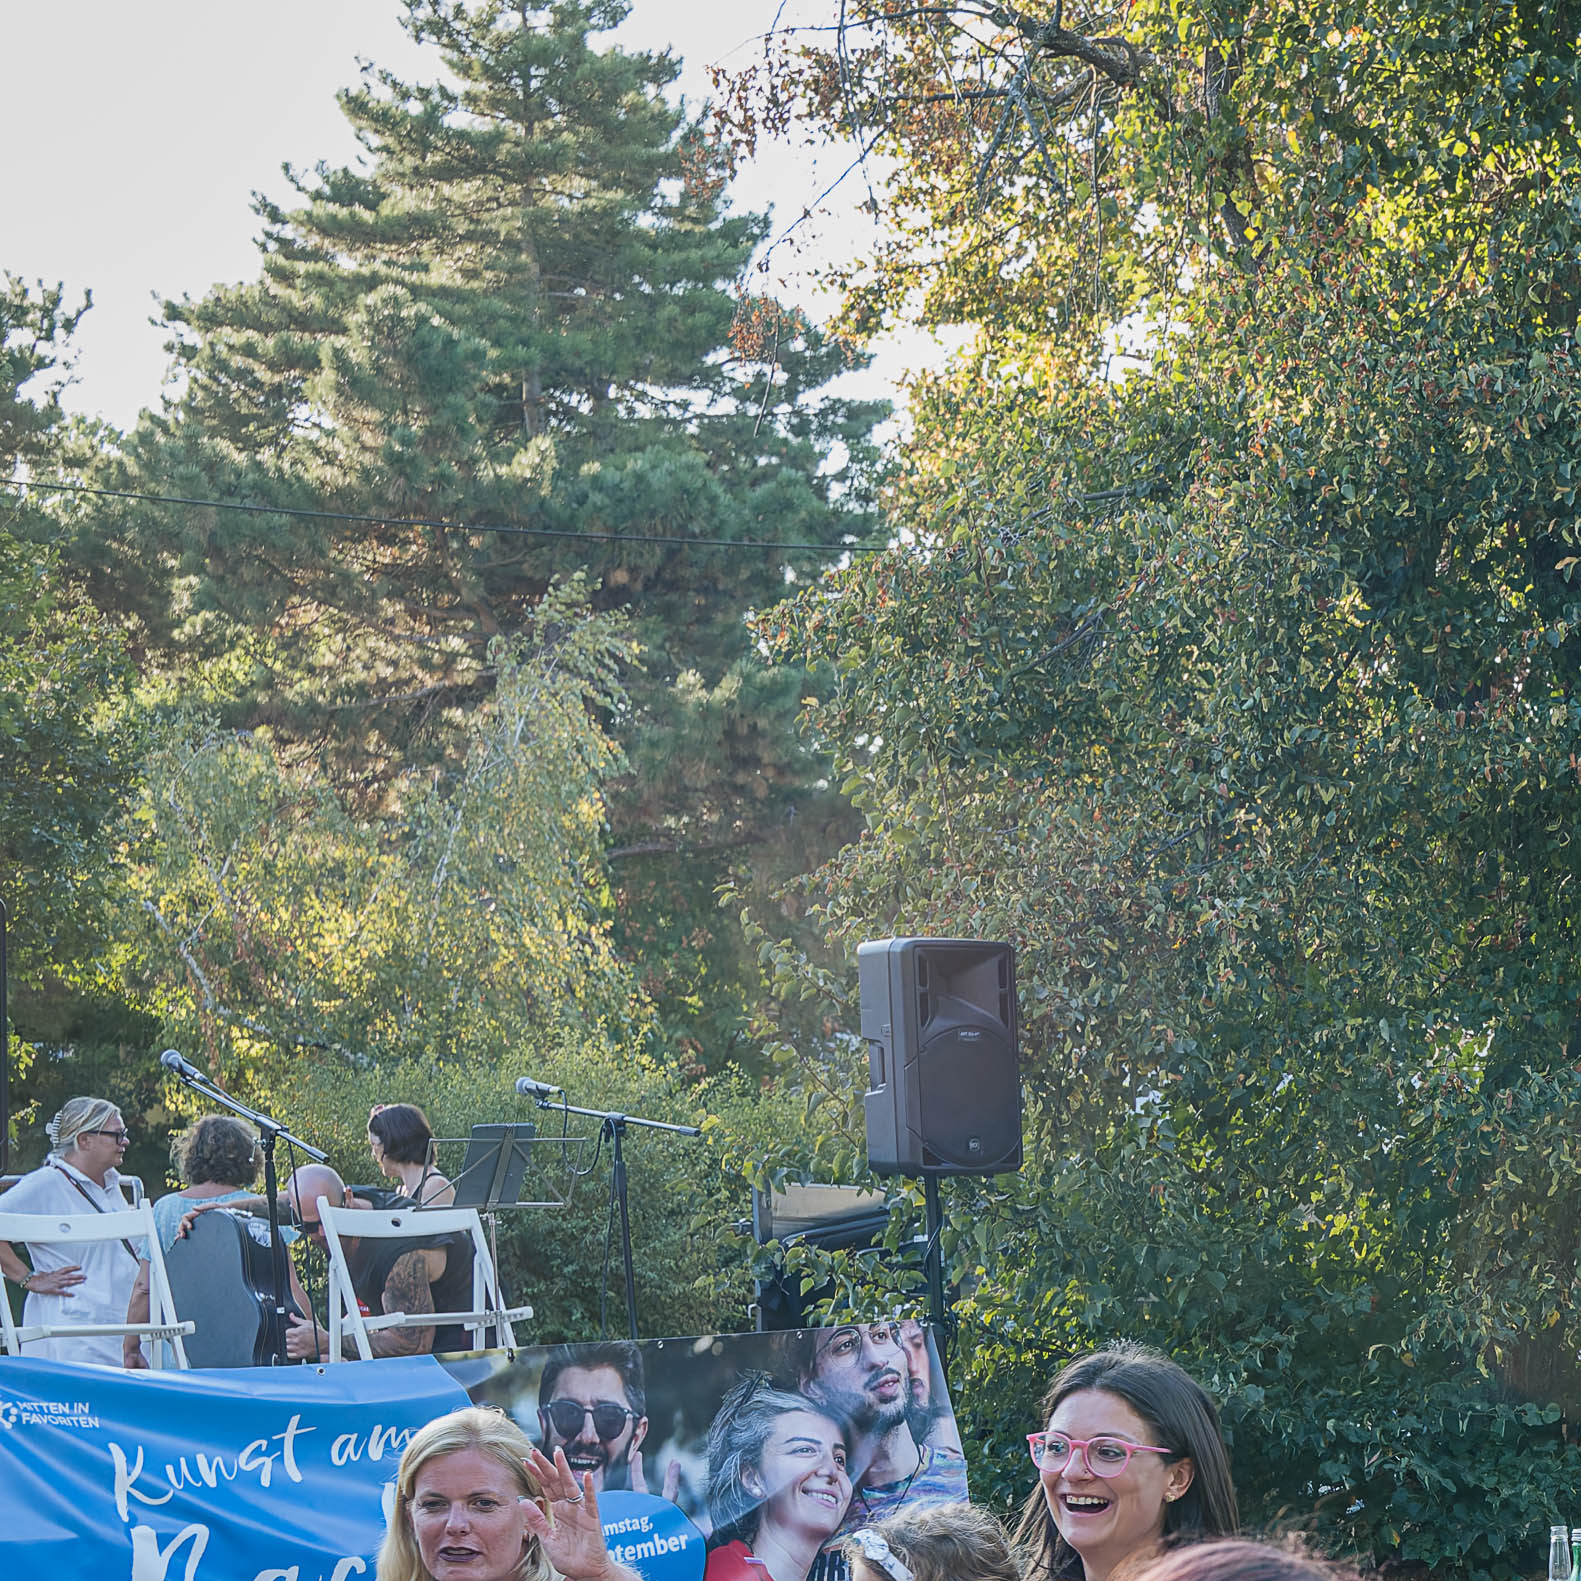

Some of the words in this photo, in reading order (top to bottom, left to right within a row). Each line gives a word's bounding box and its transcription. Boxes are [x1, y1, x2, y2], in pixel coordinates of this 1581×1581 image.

[74, 1402, 89, 1414] IN
[22, 1412, 99, 1428] FAVORITEN
[108, 1414, 317, 1522] Kunst
[331, 1424, 413, 1466] am
[602, 1516, 653, 1537] mstag,
[608, 1534, 688, 1561] tember
